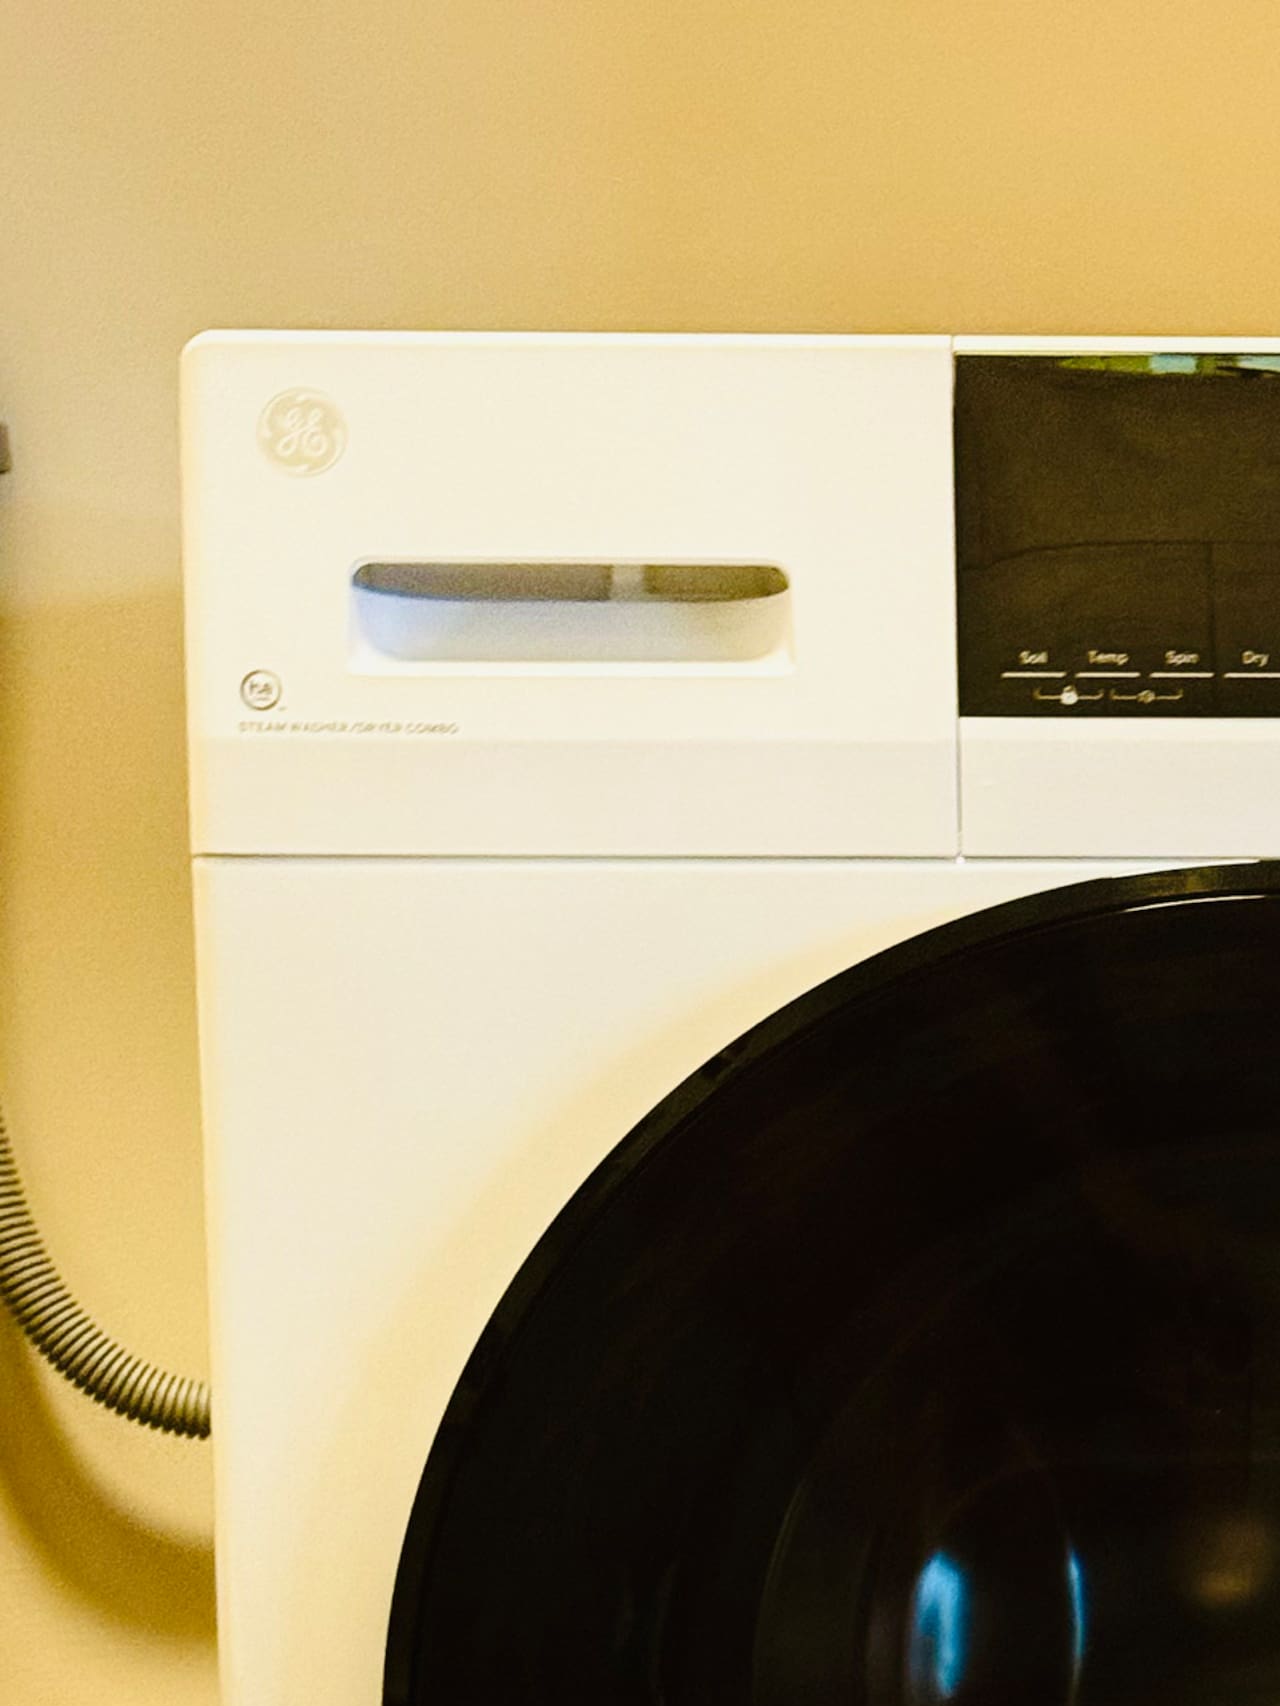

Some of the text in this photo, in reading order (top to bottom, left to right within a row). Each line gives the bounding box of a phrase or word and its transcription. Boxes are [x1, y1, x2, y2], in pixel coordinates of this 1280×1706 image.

[1019, 651, 1048, 665] Soil
[1087, 650, 1130, 666] Temp
[1164, 650, 1199, 666] Spin
[1241, 650, 1270, 667] Dry
[238, 721, 287, 733] STEAM
